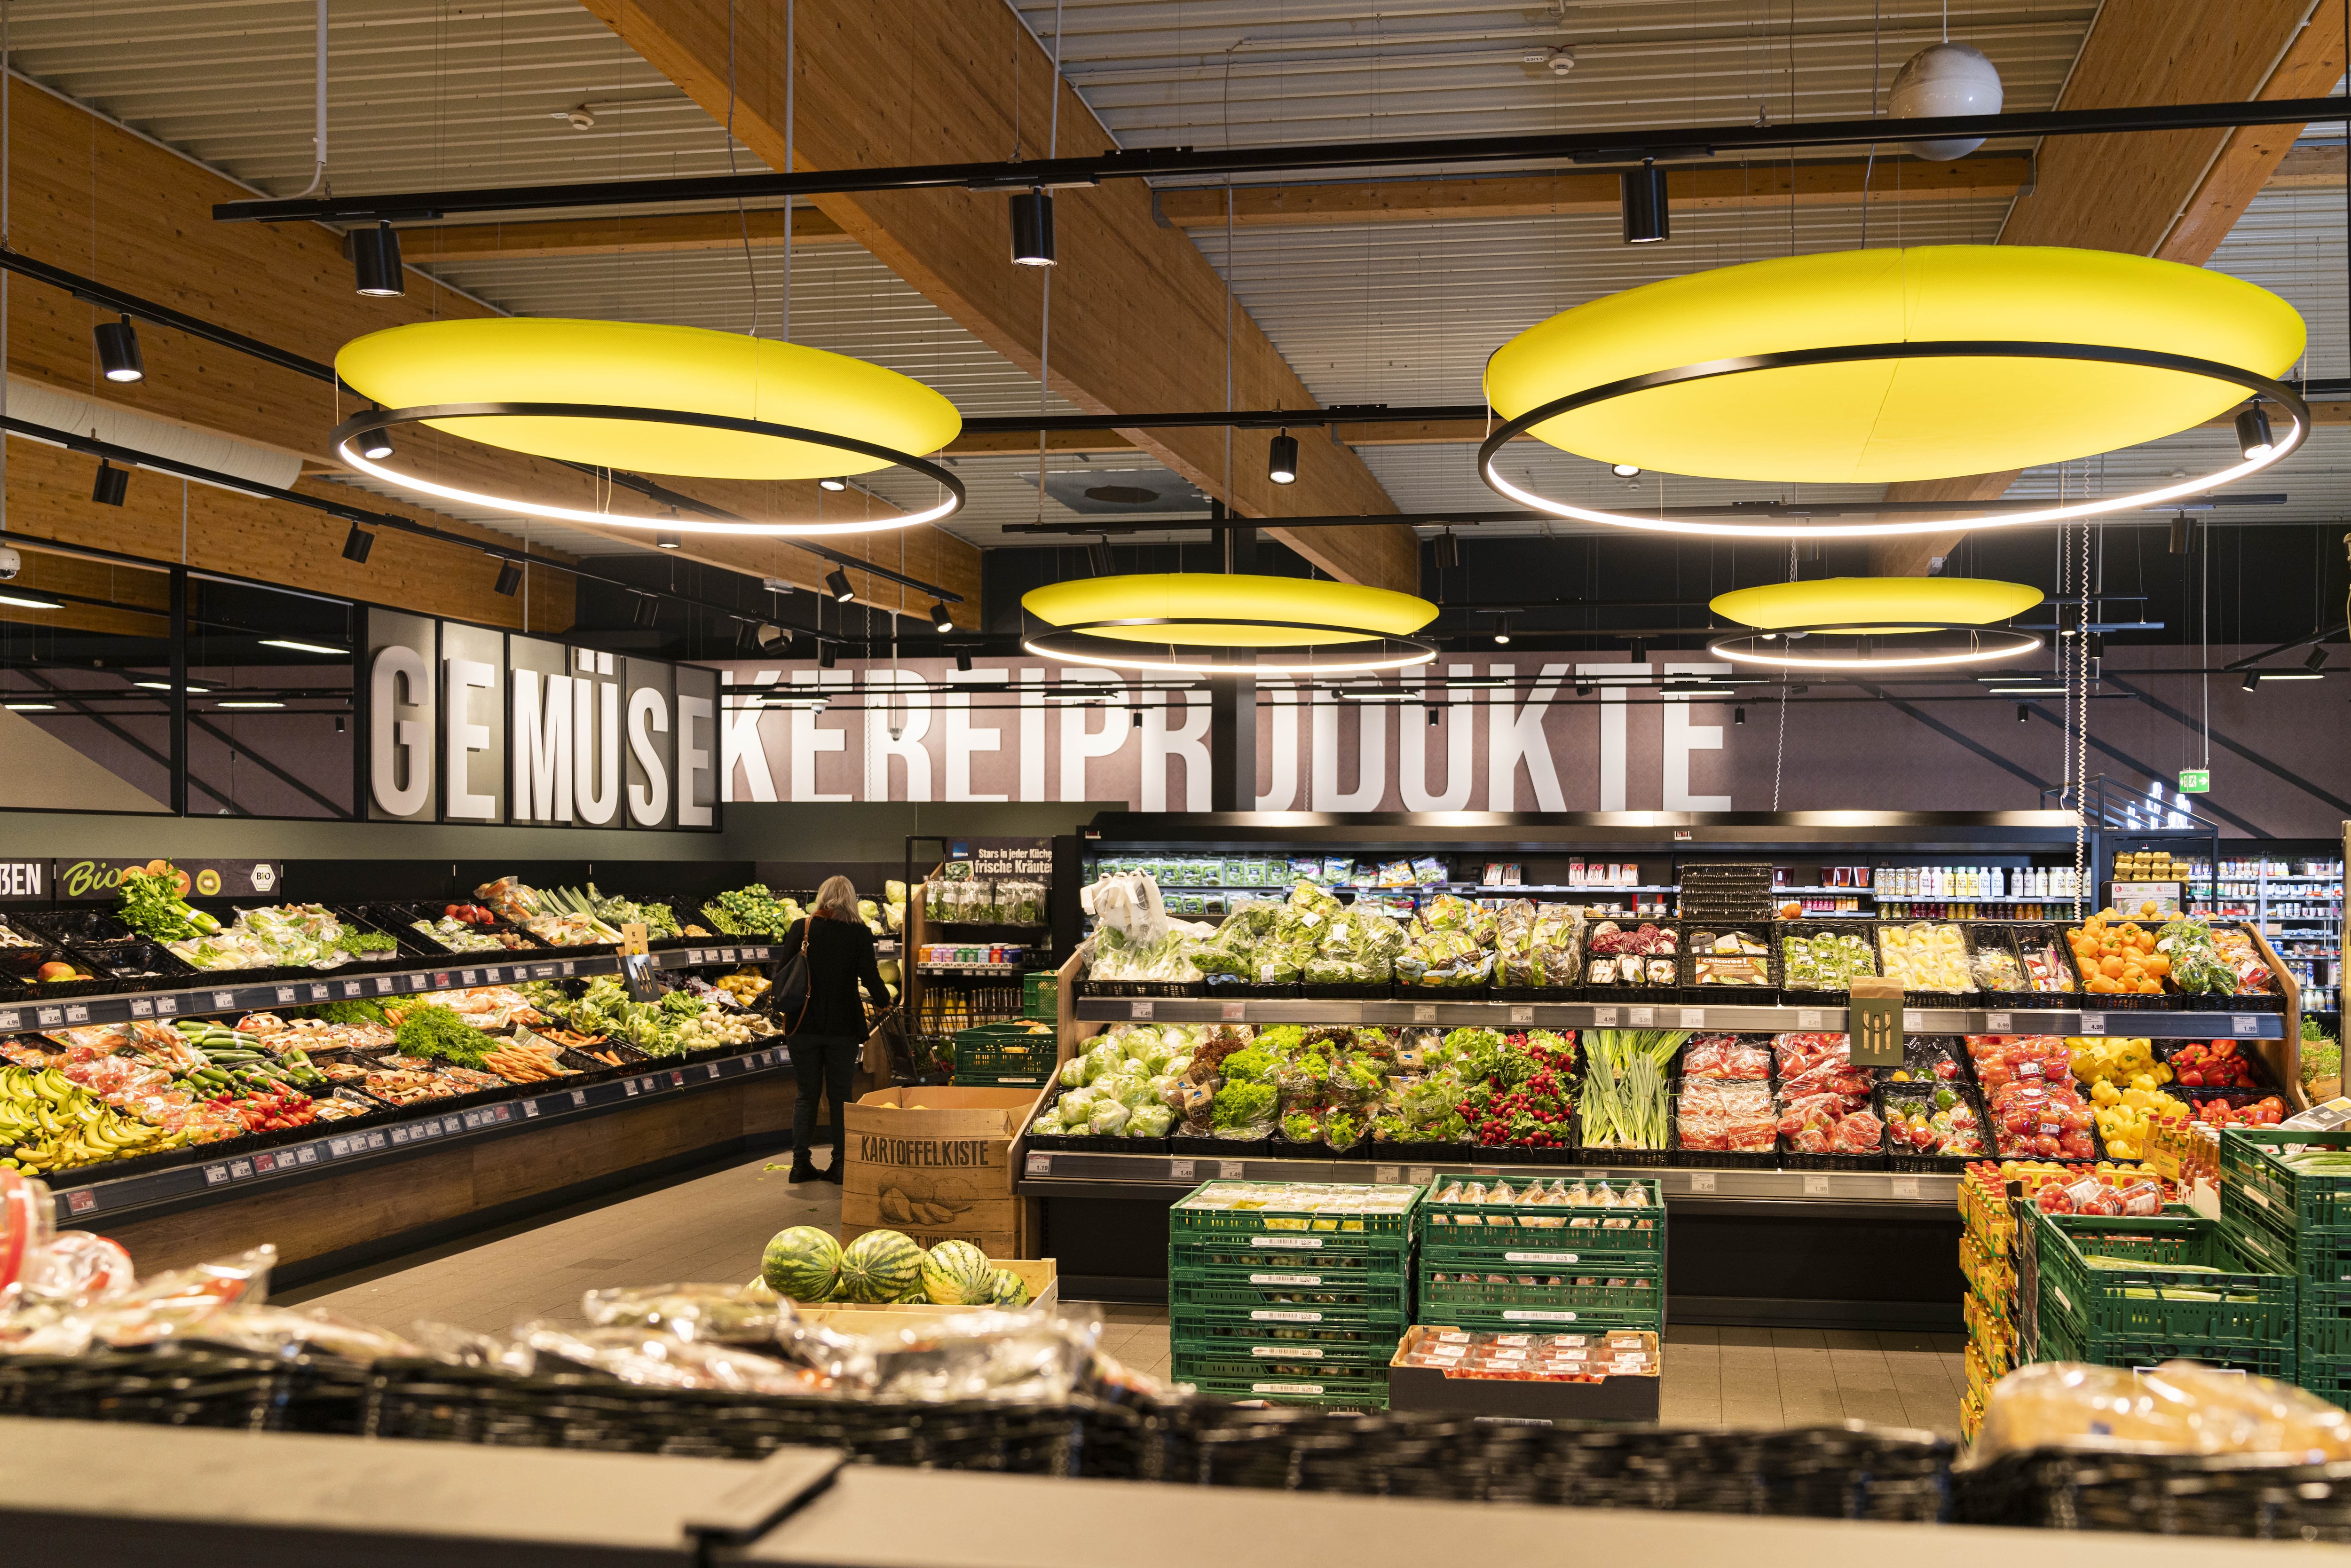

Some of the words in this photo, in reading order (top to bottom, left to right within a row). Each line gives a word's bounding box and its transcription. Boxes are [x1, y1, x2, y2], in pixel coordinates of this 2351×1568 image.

[371, 646, 712, 826] GEMÜSE
[975, 859, 1012, 873] frische
[978, 849, 999, 859] Stars
[1000, 849, 1007, 859] in
[1009, 849, 1028, 860] jeder
[63, 861, 123, 897] Bio
[861, 1136, 988, 1166] KARTOFFELKISTE
